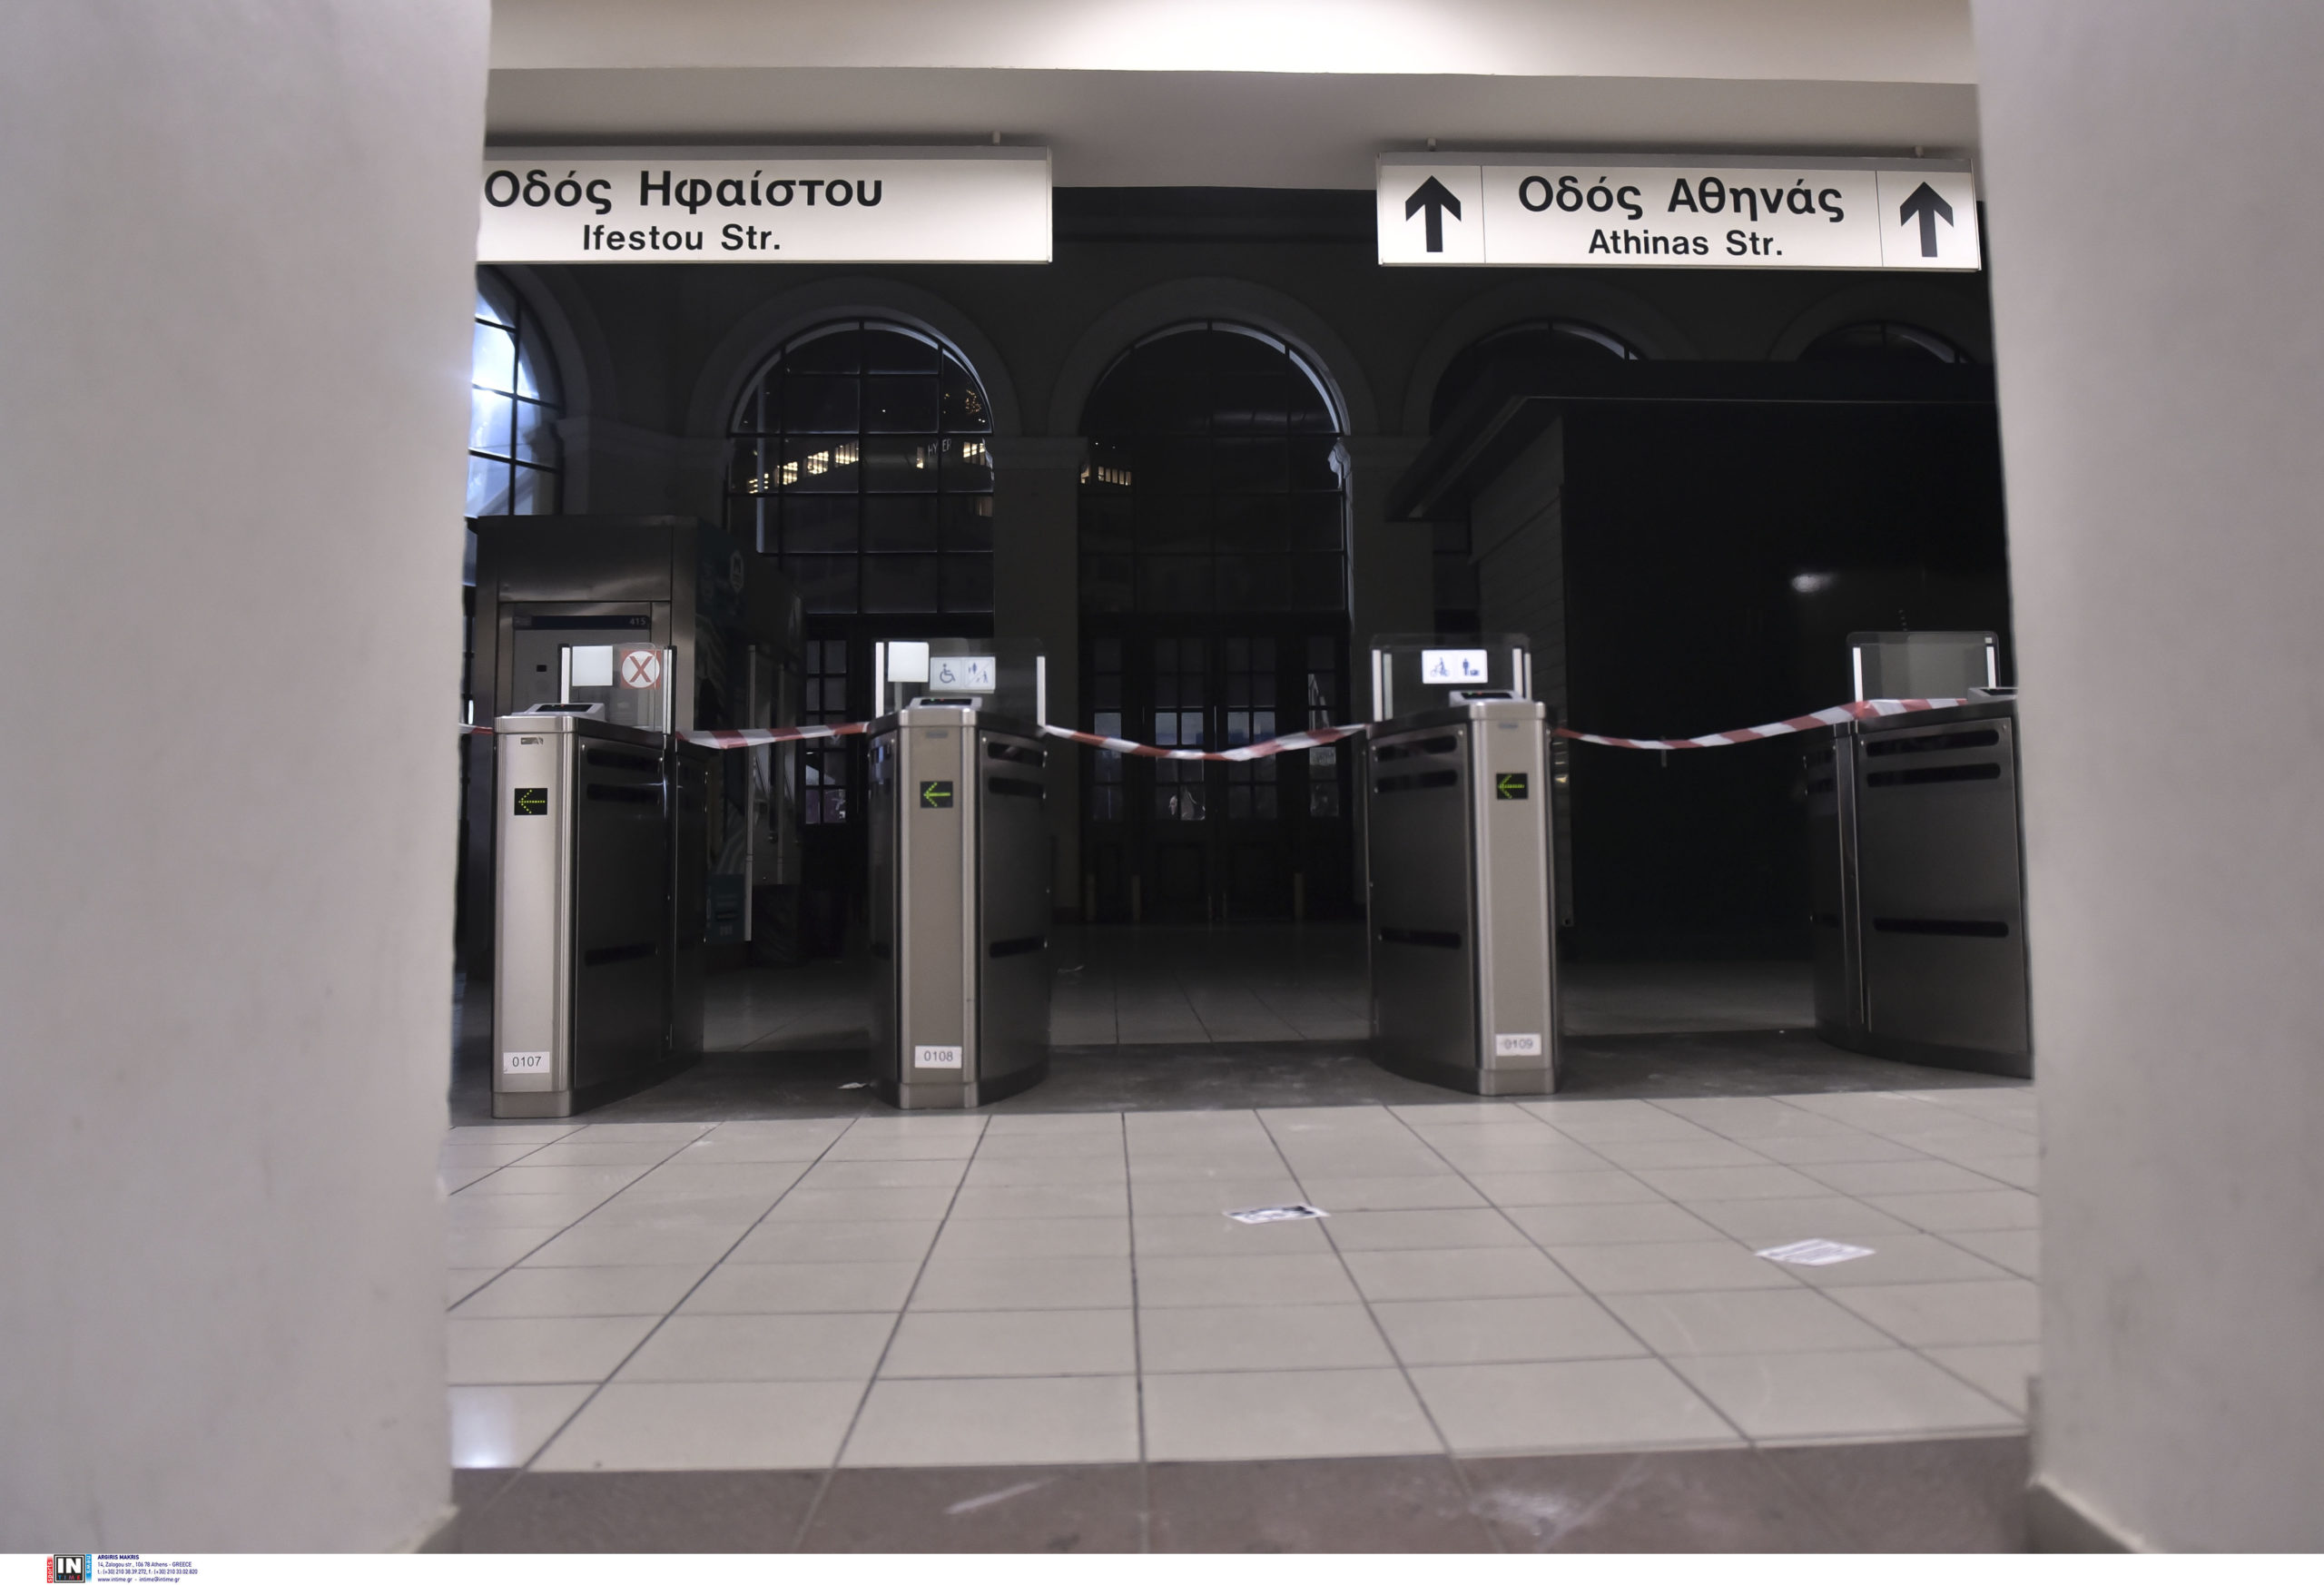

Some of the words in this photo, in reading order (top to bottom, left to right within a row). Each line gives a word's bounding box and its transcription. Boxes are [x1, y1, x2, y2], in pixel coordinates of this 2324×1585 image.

[484, 169, 612, 215] Οδός
[639, 170, 883, 215] Ηφαίστου
[1518, 175, 1644, 221] Οδός
[1667, 176, 1845, 222] Αθηνάς
[583, 224, 704, 251] Ifestou
[721, 223, 781, 251] Str.
[1588, 229, 1709, 255] Athinas
[1726, 229, 1783, 256] Str.
[629, 617, 646, 625] 415
[512, 1056, 542, 1068] 0107
[923, 1050, 953, 1062] 0108
